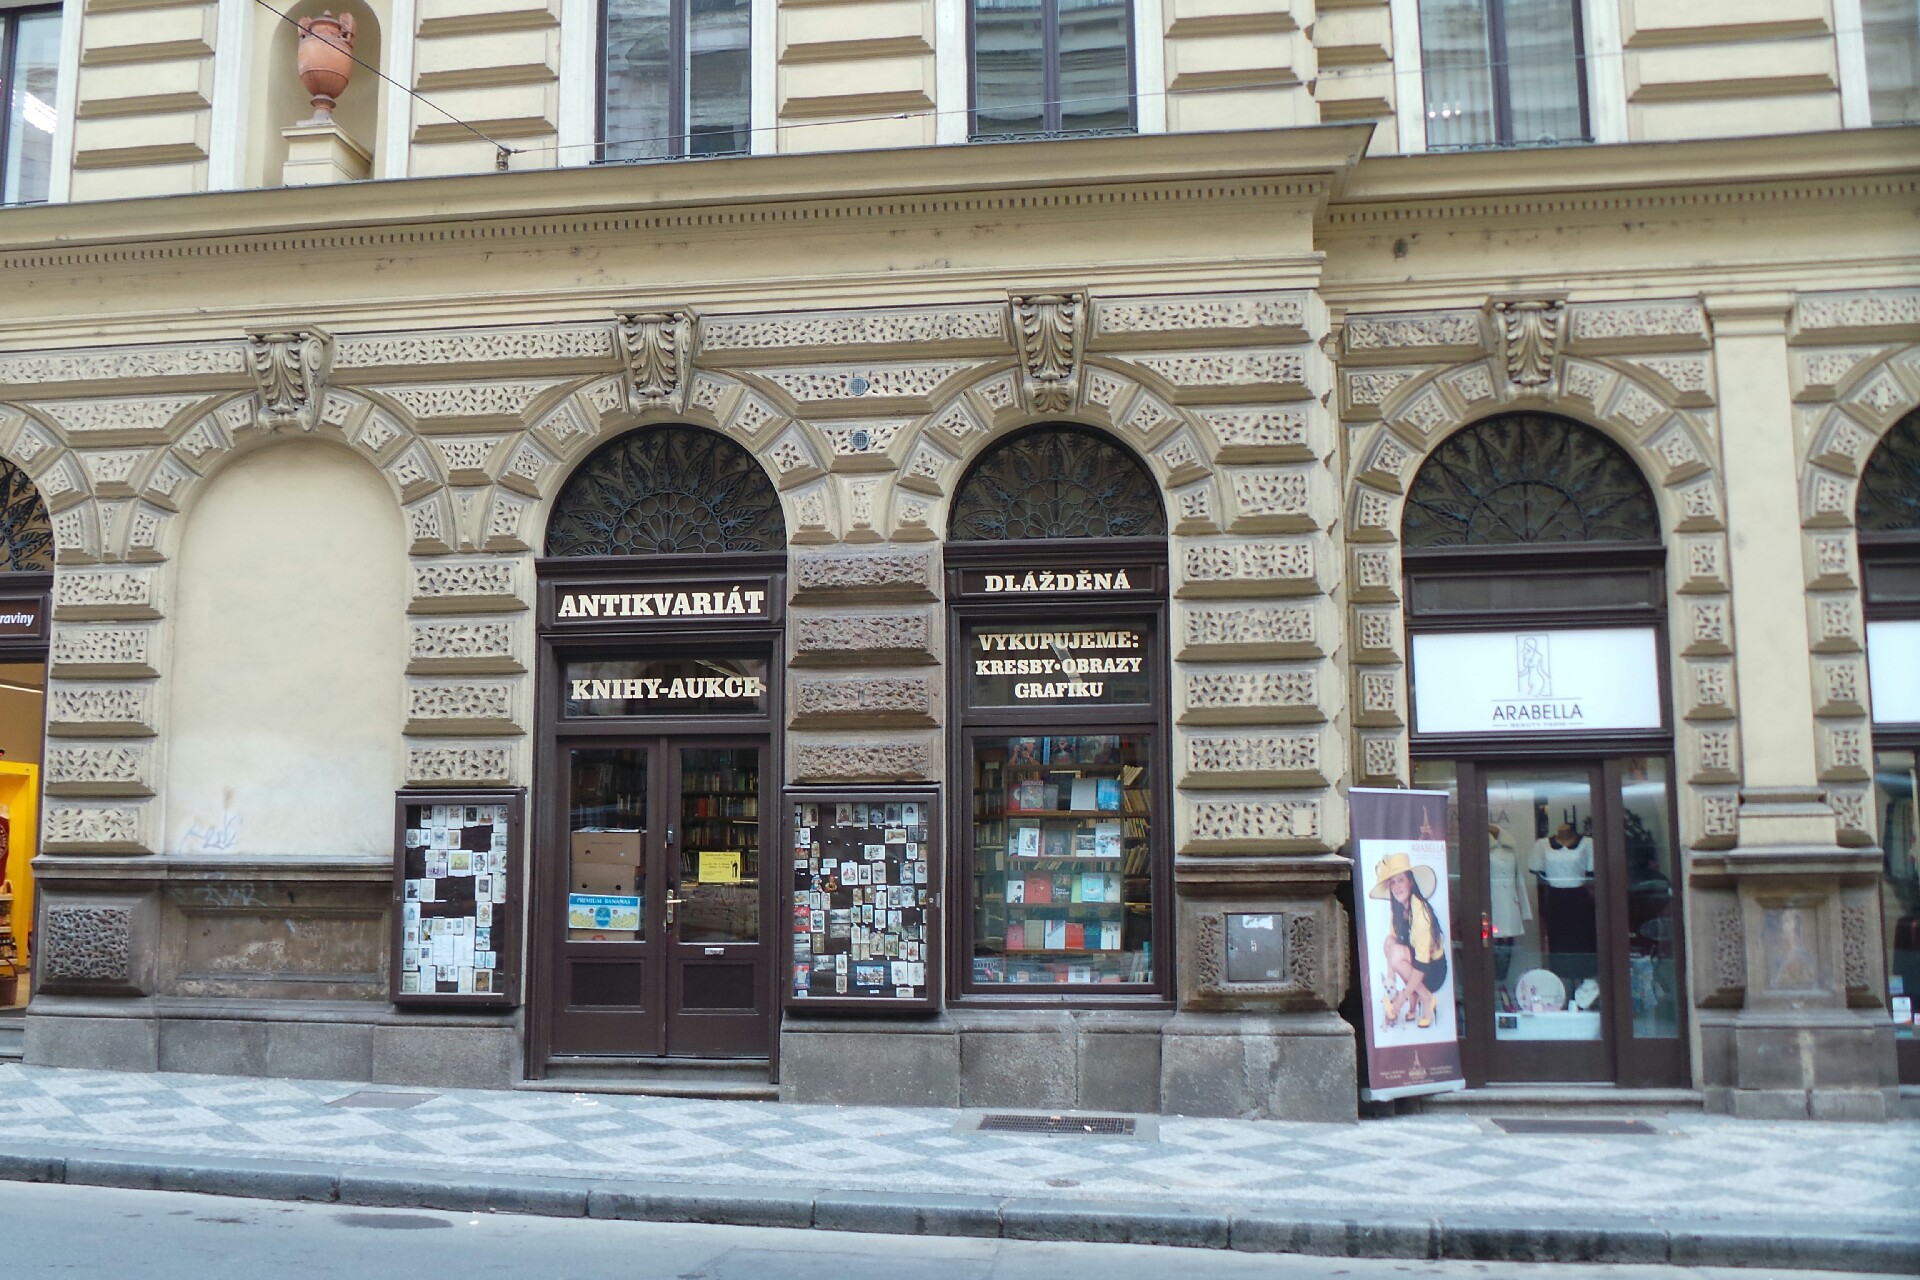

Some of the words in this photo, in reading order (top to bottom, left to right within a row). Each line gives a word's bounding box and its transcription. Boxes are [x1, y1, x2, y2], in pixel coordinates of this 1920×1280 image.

[985, 569, 1130, 592] DLÁŽDĚNÁ
[557, 585, 764, 618] ANTIKVARIÁT
[978, 631, 1139, 651] VYKUPUJEME:
[571, 676, 760, 700] KNIHY-AUKCE
[1014, 682, 1103, 698] GRAFIKU
[1492, 703, 1583, 720] ARABELLA
